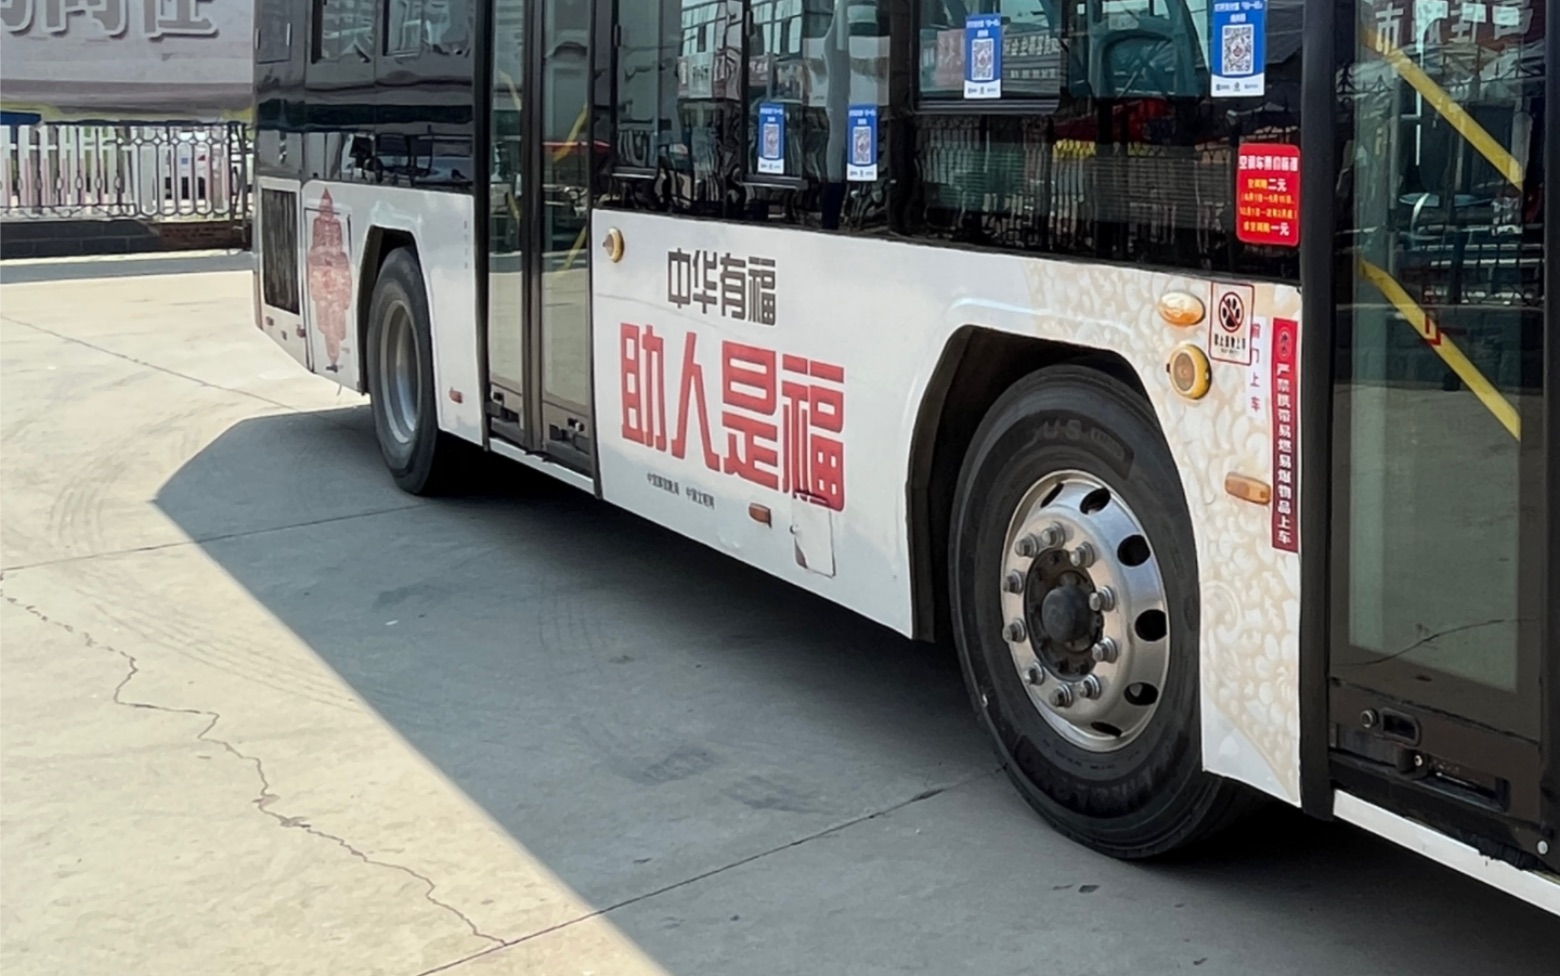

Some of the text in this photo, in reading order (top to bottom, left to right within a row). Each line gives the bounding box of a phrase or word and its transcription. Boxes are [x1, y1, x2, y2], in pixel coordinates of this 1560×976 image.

[667, 247, 777, 326] 中华有福
[620, 322, 846, 512] 助人是福
